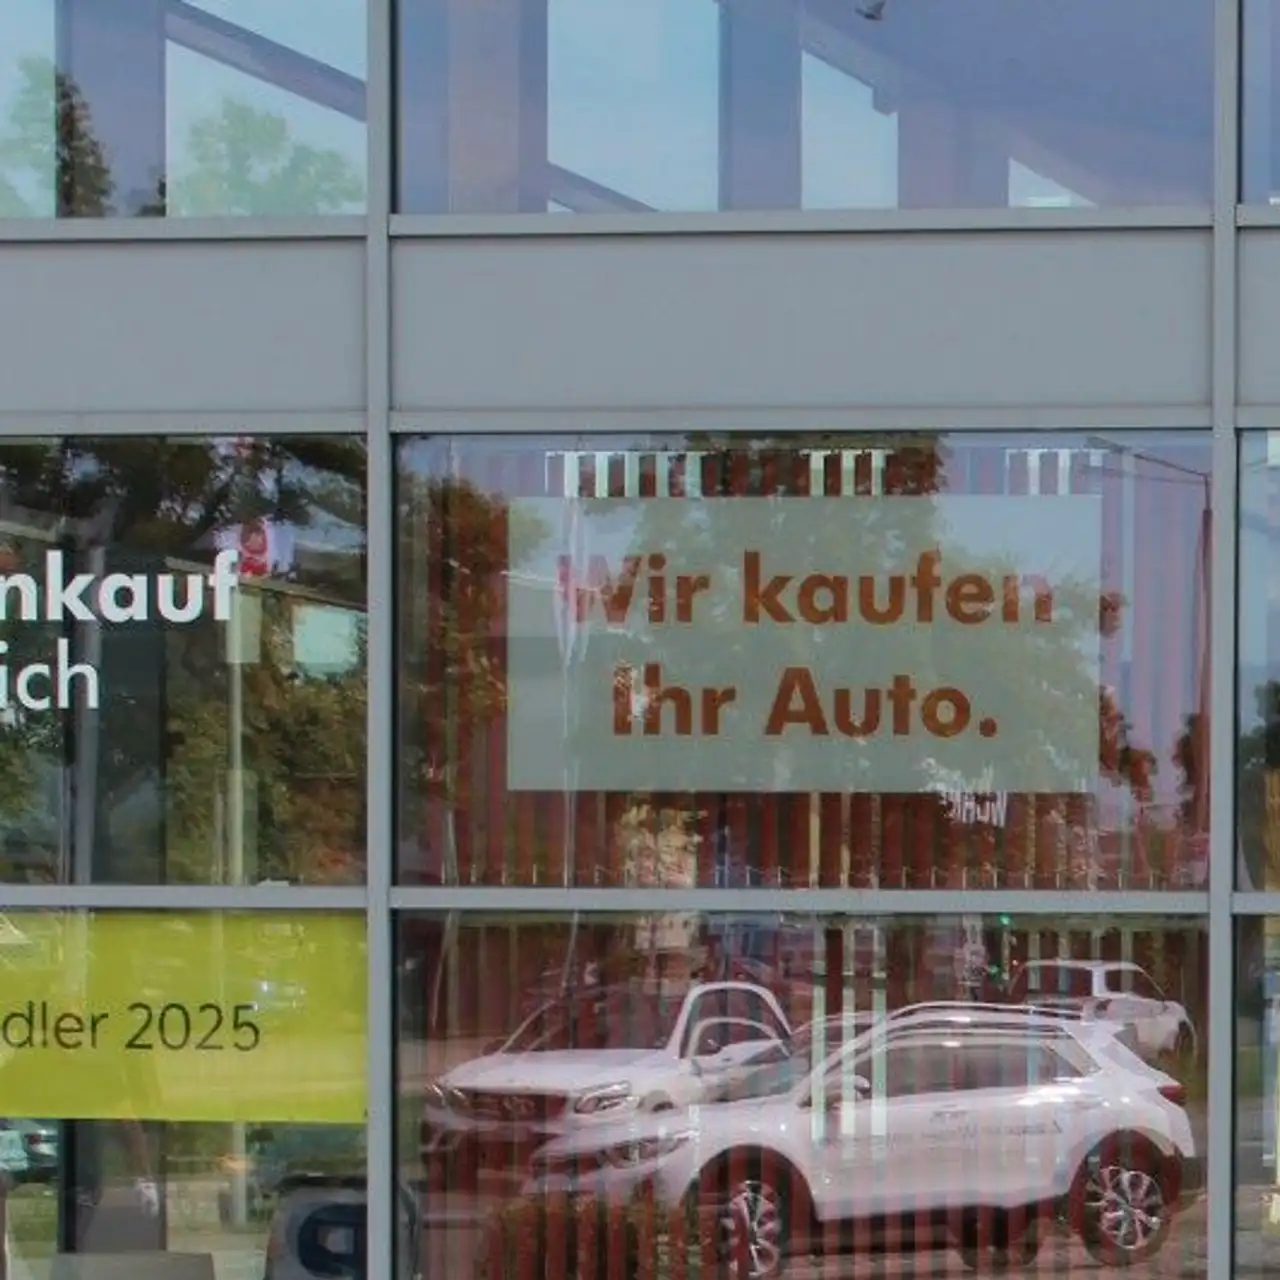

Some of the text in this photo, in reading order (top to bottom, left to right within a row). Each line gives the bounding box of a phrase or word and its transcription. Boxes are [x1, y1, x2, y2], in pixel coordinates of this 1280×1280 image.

[0, 549, 240, 623] nkauf
[556, 548, 1055, 625] Wir kaufen
[612, 661, 998, 738] Ihr Auto.
[1, 1000, 261, 1051] dler 2025
